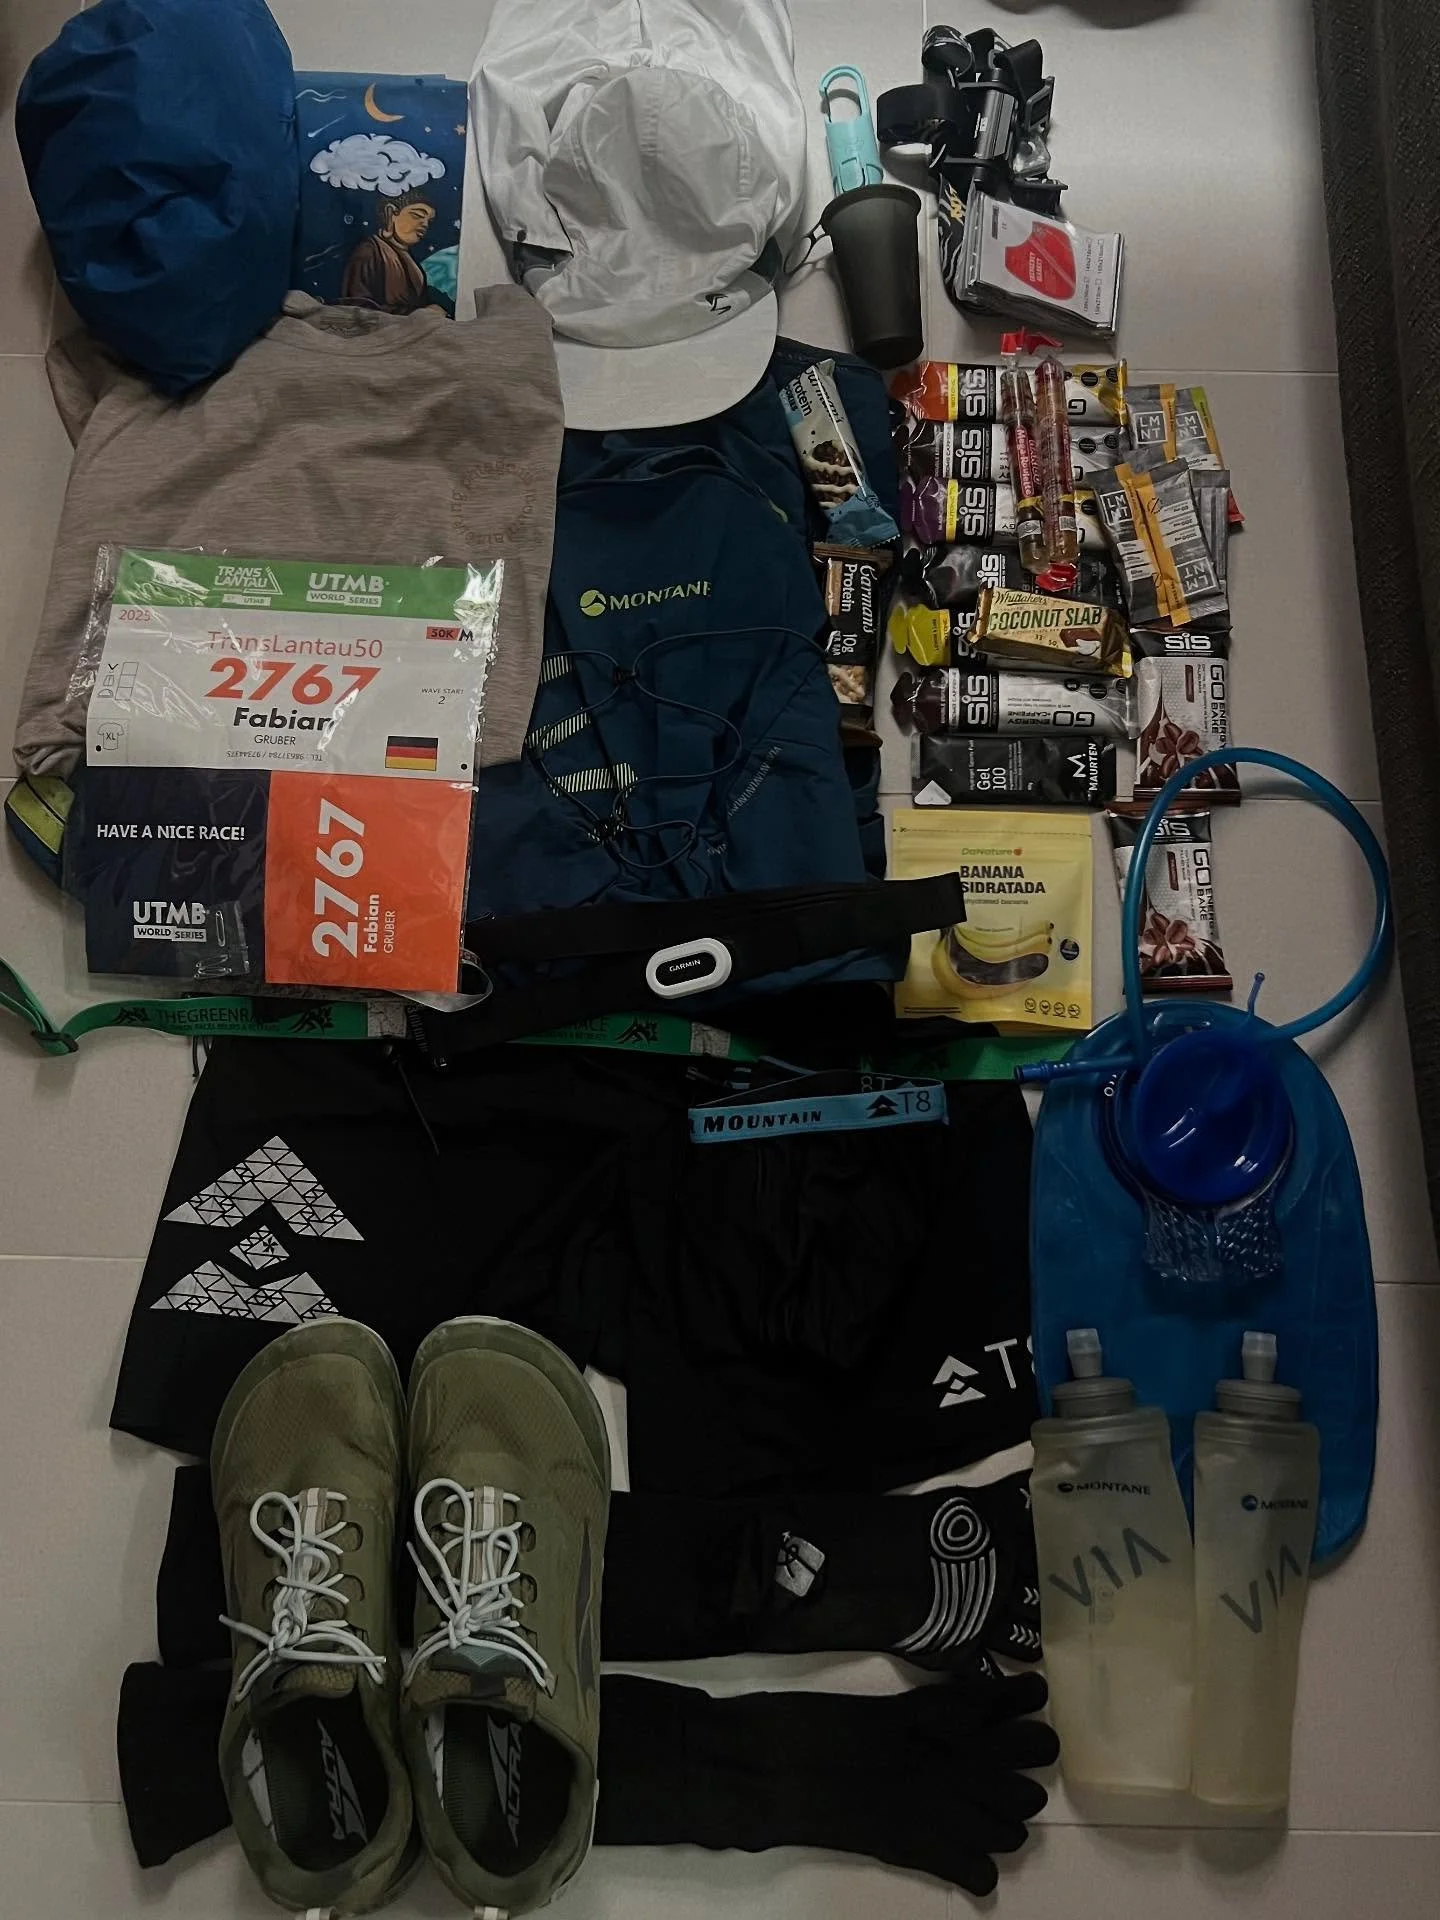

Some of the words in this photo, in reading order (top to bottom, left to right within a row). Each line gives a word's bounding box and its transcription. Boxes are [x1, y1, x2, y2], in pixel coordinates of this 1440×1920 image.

[214, 574, 268, 588] LANTAU
[217, 565, 263, 578] TRANS
[308, 572, 385, 593] UTMB
[311, 592, 345, 601] WORLD
[349, 596, 380, 605] SERIES
[841, 563, 858, 613] Protein
[120, 609, 151, 621] 2025
[989, 608, 1064, 631] COCONUT
[1065, 607, 1103, 627] SLAB
[208, 630, 383, 659] TransLantau50
[431, 628, 454, 638] 50K
[204, 657, 382, 706] 2767
[1210, 664, 1225, 701] GO
[438, 696, 446, 705] 2
[1052, 711, 1095, 728] GO
[1211, 702, 1219, 734] BAKE
[1218, 702, 1227, 746] ENERG
[106, 732, 116, 741] XL
[254, 734, 296, 746] GRUBER
[1088, 743, 1098, 791] MAURTEN
[976, 767, 991, 791] Gel
[992, 767, 1007, 791] 100
[96, 824, 139, 840] HAVE
[141, 825, 153, 839] A
[156, 824, 197, 840] NICE
[199, 826, 246, 842] RACE!
[312, 798, 366, 959] 2767
[960, 865, 1024, 879] BANANA
[1194, 848, 1211, 886] GO
[960, 881, 1046, 894] SIDRATADA
[133, 901, 206, 924] UTMB
[363, 894, 380, 953] Fabian
[137, 926, 171, 938] WORLD
[174, 930, 205, 941] SERIES
[383, 910, 396, 954] GRUBER
[669, 959, 701, 972] GARMIN
[898, 1091, 931, 1115] T8
[703, 1110, 823, 1133] MOUNTAIN
[984, 1334, 1035, 1389] T
[1077, 1481, 1151, 1496] MONTANE
